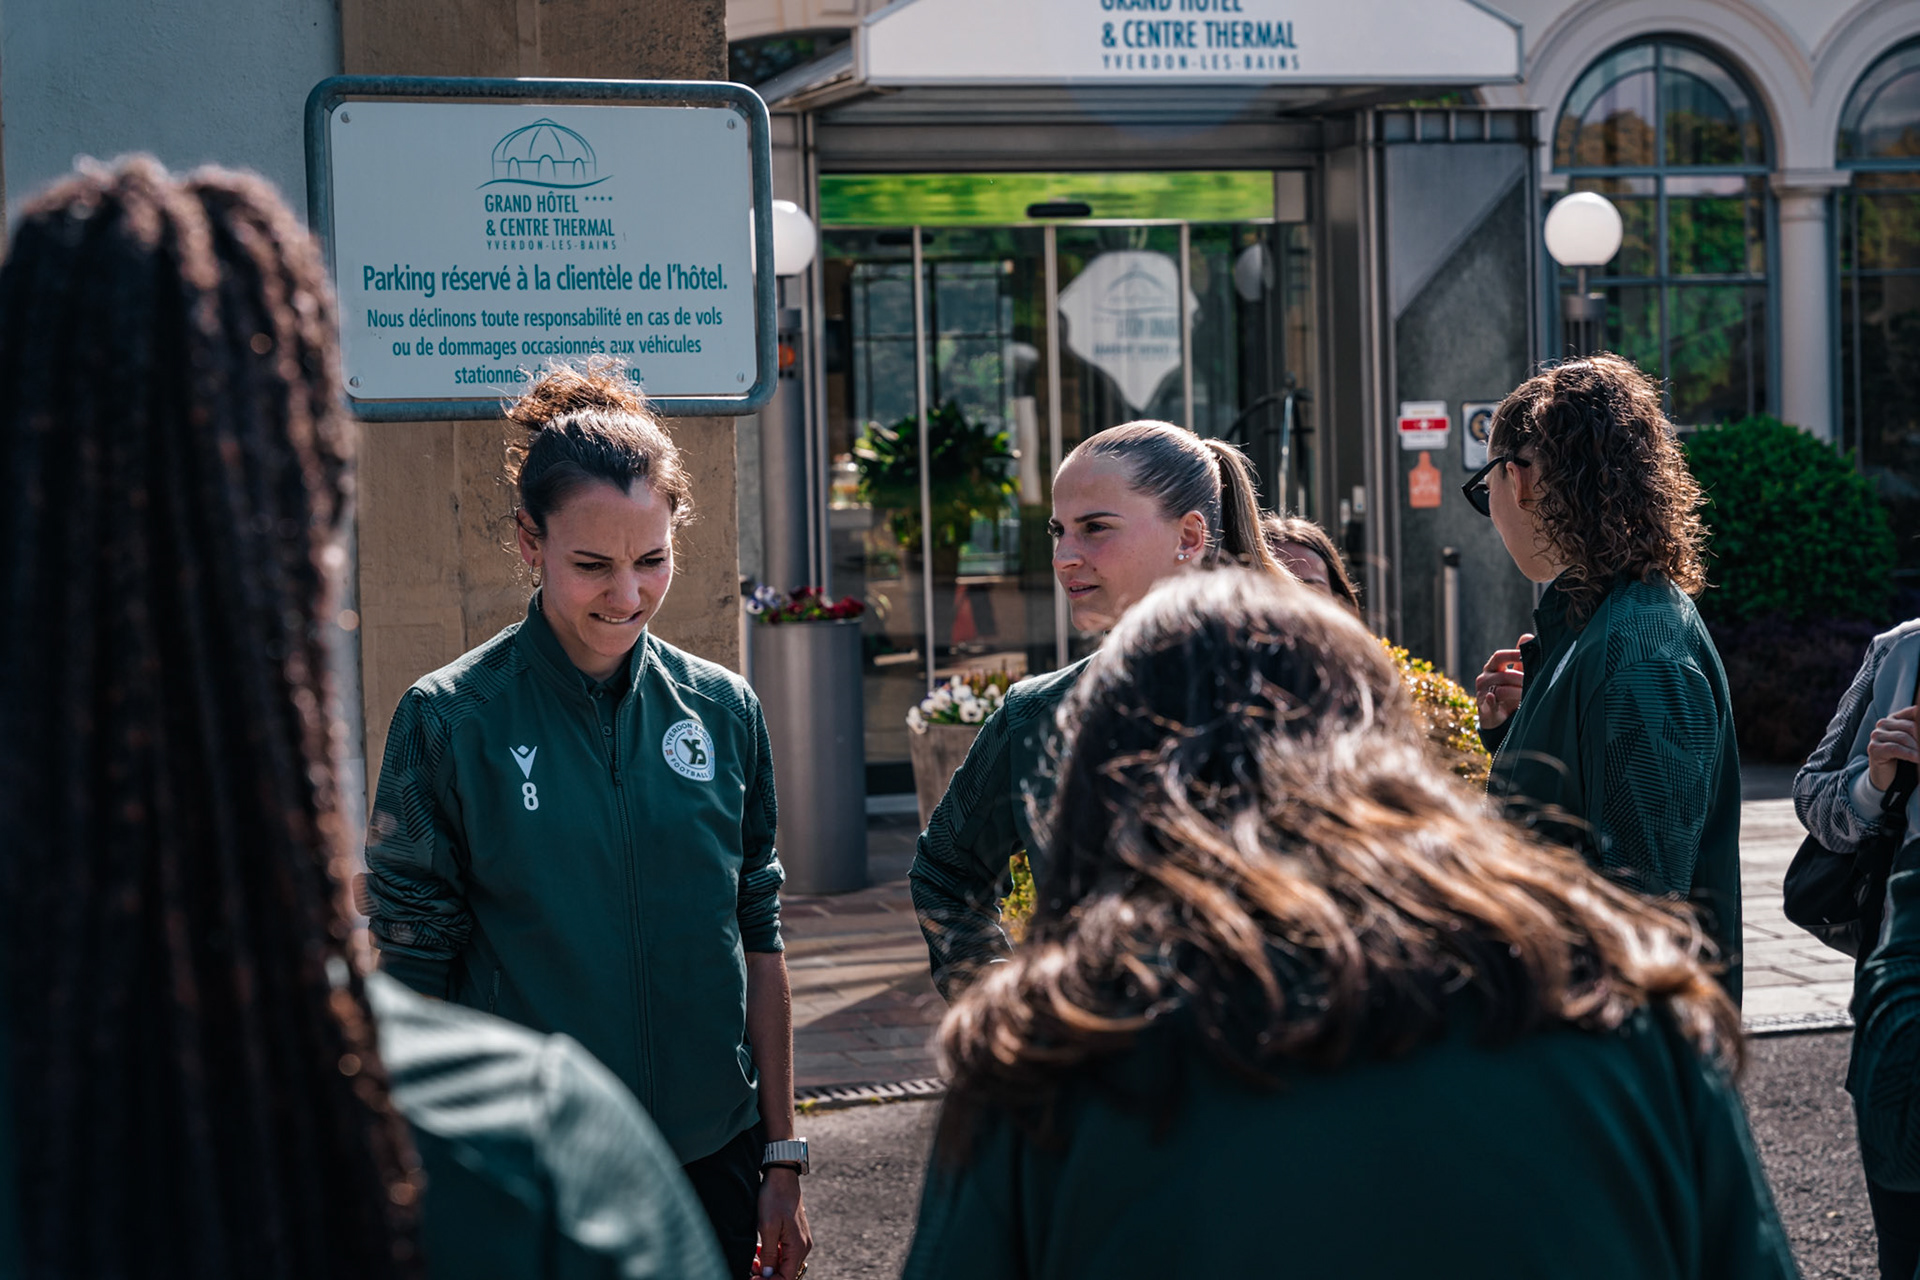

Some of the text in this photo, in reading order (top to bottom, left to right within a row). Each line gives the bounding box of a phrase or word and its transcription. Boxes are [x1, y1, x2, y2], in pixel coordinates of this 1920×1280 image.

[1101, 20, 1298, 49] & CENTRE THERMAL
[1103, 54, 1300, 70] YVERDON-LES-BAINS
[484, 190, 579, 213] GRAND HÔTEL
[486, 218, 615, 236] & CENTRE THERMAL
[487, 240, 617, 251] YVERDON-LES-BAINS
[363, 264, 435, 298] Parking
[442, 264, 511, 291] réservé
[516, 264, 528, 290] à
[534, 263, 551, 290] la
[556, 263, 633, 290] clientèle
[638, 263, 661, 290] de
[367, 306, 723, 331] Nous déclinons toute responsabilité en cas de vols
[392, 334, 702, 361] ou de dommages occasionnés aux véhicules
[454, 364, 529, 384] stationnés
[665, 723, 693, 746] YVERDON
[671, 758, 708, 778] FOOTBALL
[521, 782, 539, 811] 8
